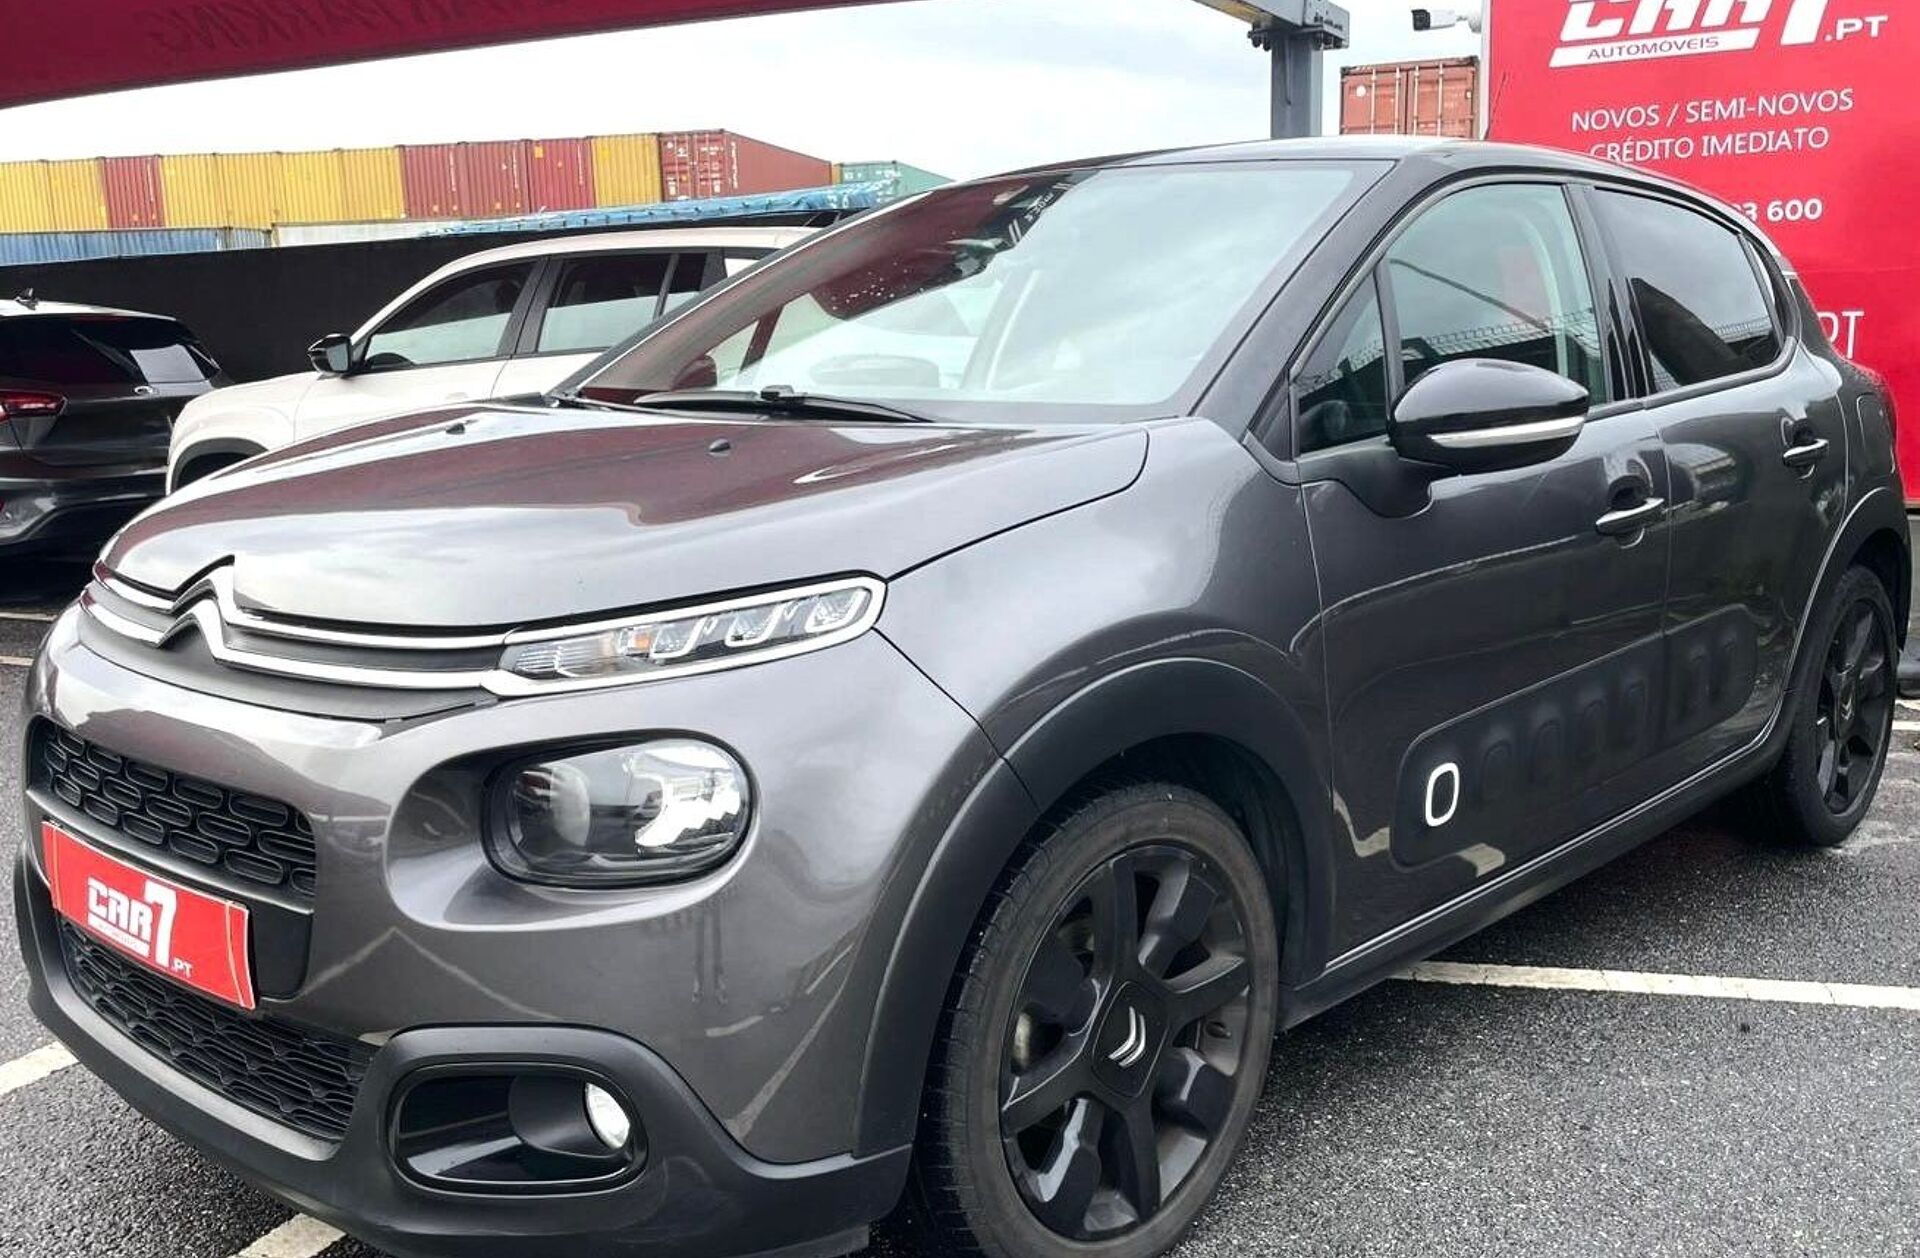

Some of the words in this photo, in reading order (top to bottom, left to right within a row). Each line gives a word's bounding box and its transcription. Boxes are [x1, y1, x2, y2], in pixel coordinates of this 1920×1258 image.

[1587, 36, 1720, 60] AUTOMÓVEIS
[1571, 104, 1660, 132] NOVOS
[1665, 102, 1679, 128] /
[1685, 88, 1854, 123] SEMI-NOVOS
[1590, 136, 1694, 162] CRÉDITO
[1701, 126, 1829, 156] IMEDIATO
[1767, 198, 1823, 222] 600
